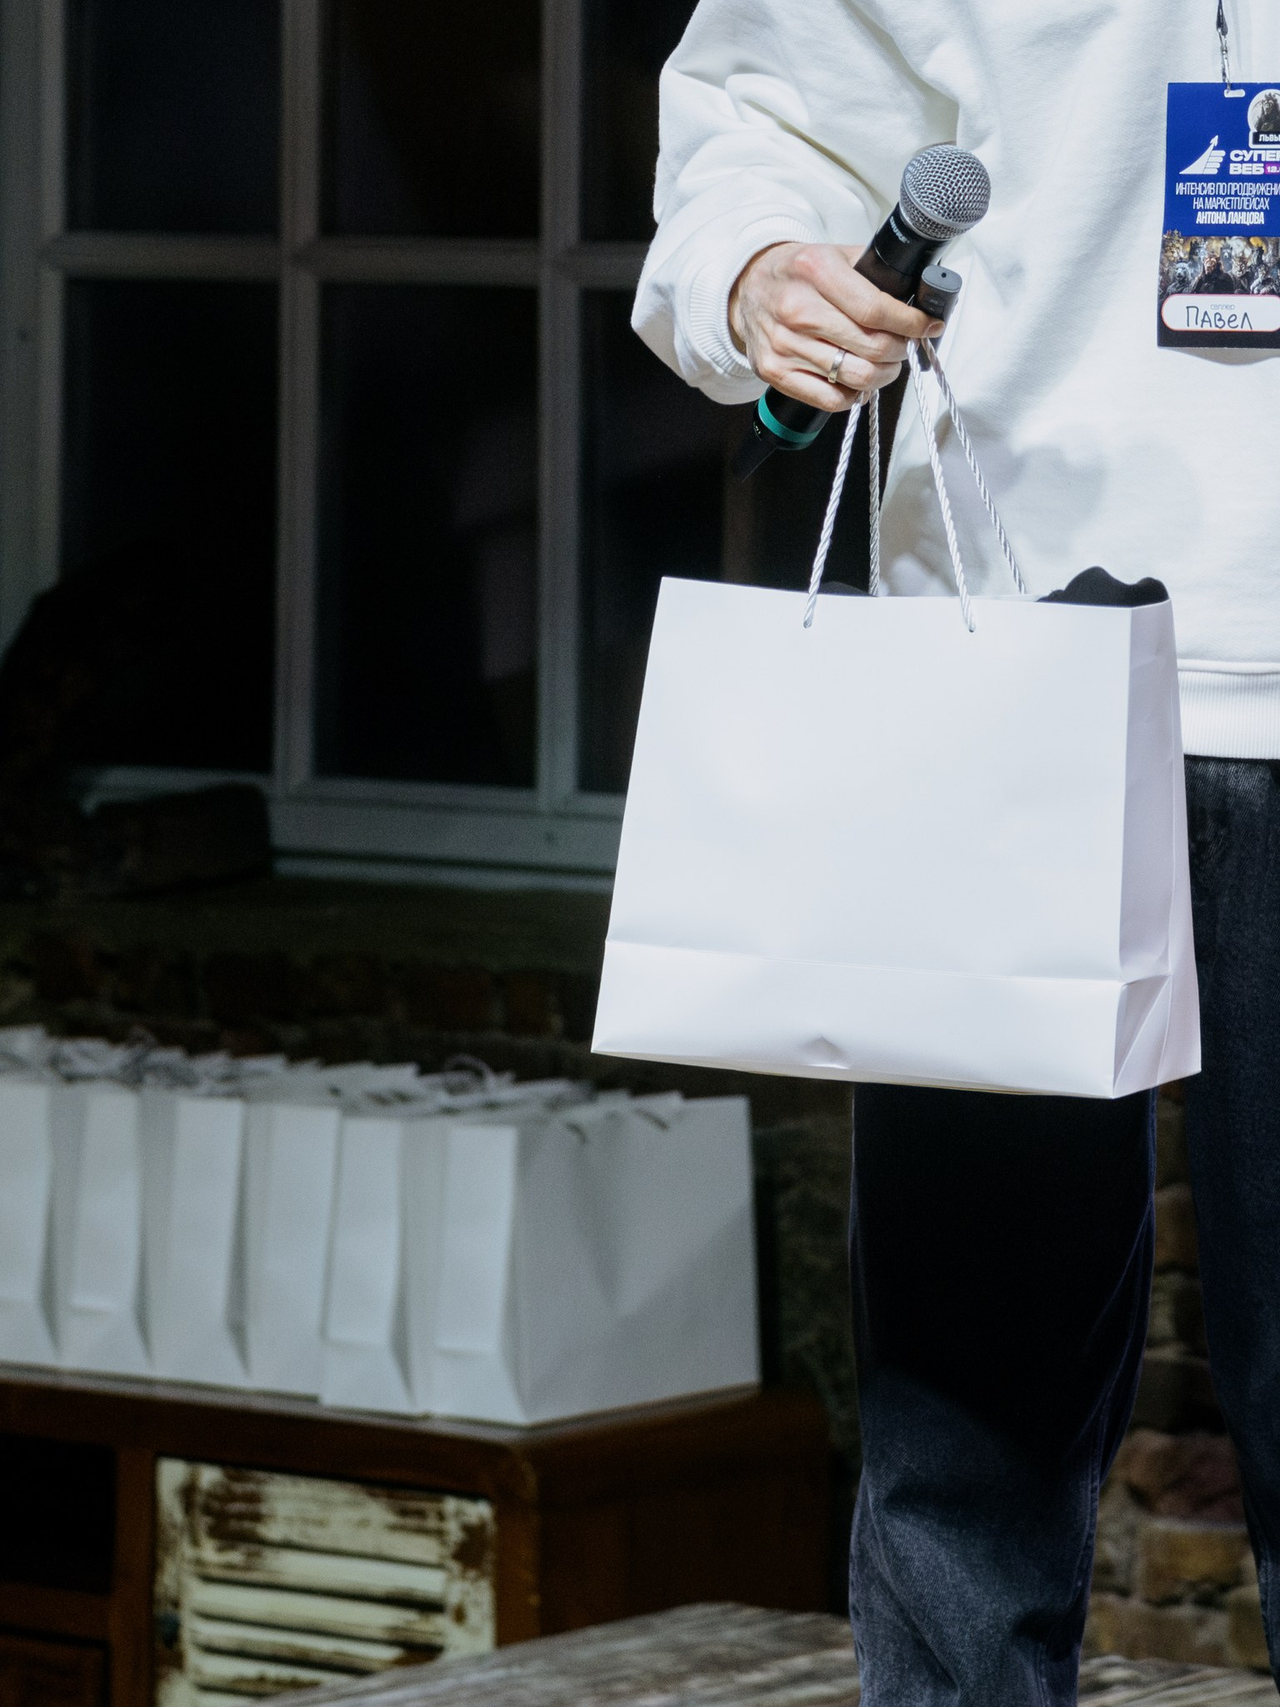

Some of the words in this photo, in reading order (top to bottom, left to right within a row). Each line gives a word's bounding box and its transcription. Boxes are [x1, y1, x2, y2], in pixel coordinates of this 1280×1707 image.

[1229, 163, 1265, 175] ВЕБ
[1175, 182, 1215, 196] ИНТЕНСИВ
[1216, 182, 1227, 195] ПО
[1193, 197, 1205, 210] НА
[1205, 195, 1270, 211] МАРКЕТПЛЕЙСАХ
[1196, 211, 1227, 225] АНТОНА
[1227, 211, 1265, 226] ЛАНЦОВА
